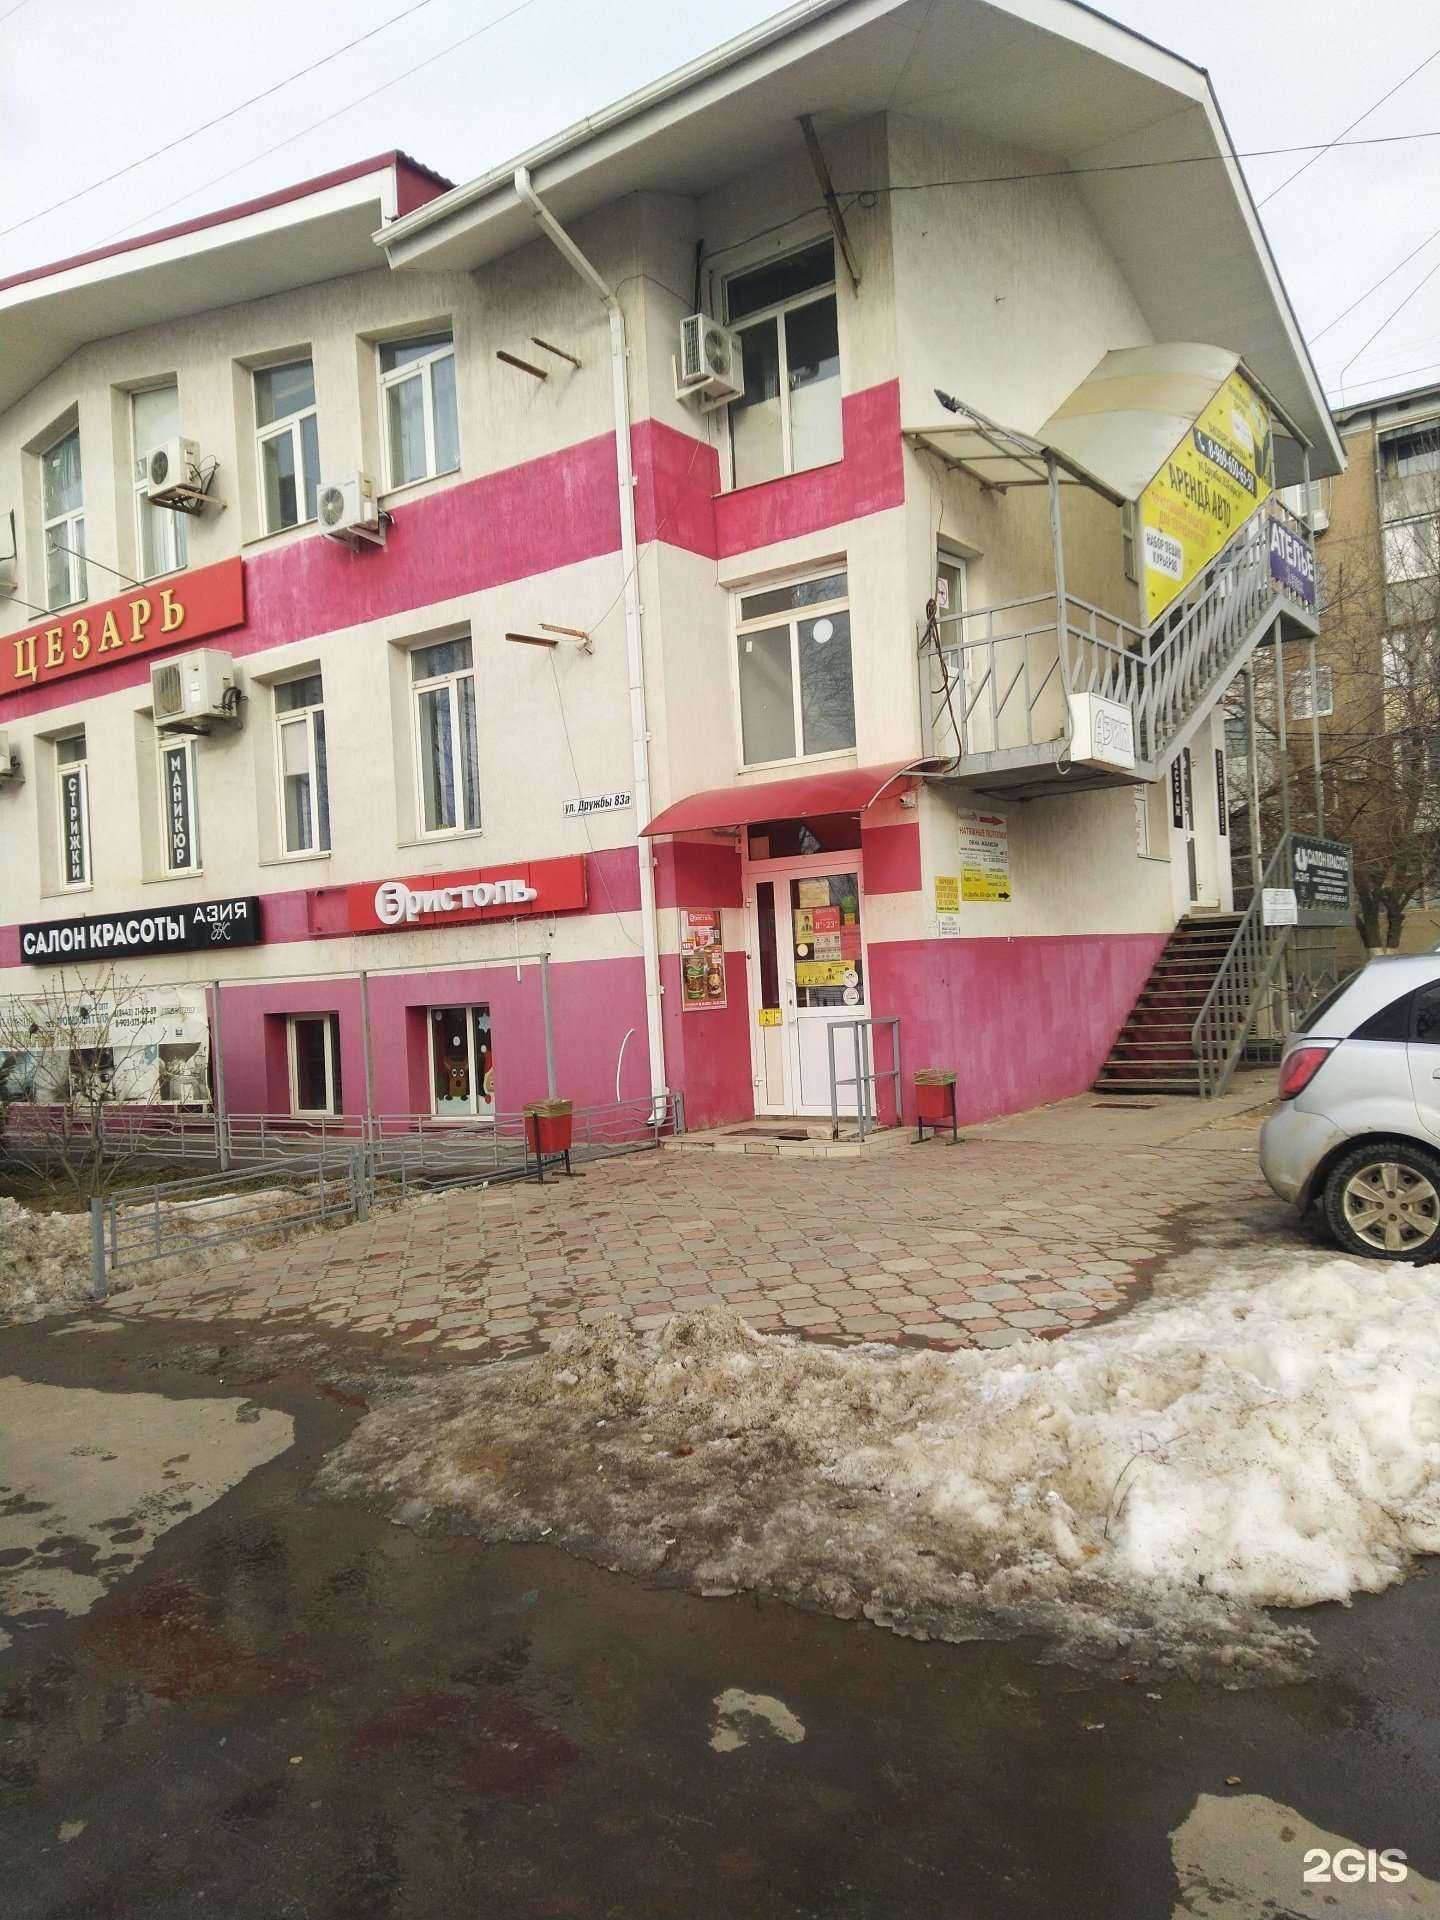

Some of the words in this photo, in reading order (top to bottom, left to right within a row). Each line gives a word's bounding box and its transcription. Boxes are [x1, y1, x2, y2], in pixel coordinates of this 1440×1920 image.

[1168, 463, 1210, 513] АРЕНДА
[1211, 493, 1231, 529] АВТО
[1270, 522, 1314, 582] АТЕЛЬЕ
[13, 588, 186, 683] ЦЕЗАРЬ
[68, 777, 82, 879] СТРИЖКИ
[170, 755, 187, 864] МАНИКЮР
[564, 803, 576, 815] ул.
[578, 797, 612, 814] Дружбы
[614, 794, 630, 806] 83а
[193, 901, 247, 923] АЗИЯ
[375, 879, 538, 925] Бристоль
[23, 925, 85, 955] САЛОН
[90, 915, 186, 948] КРАСОТЫ
